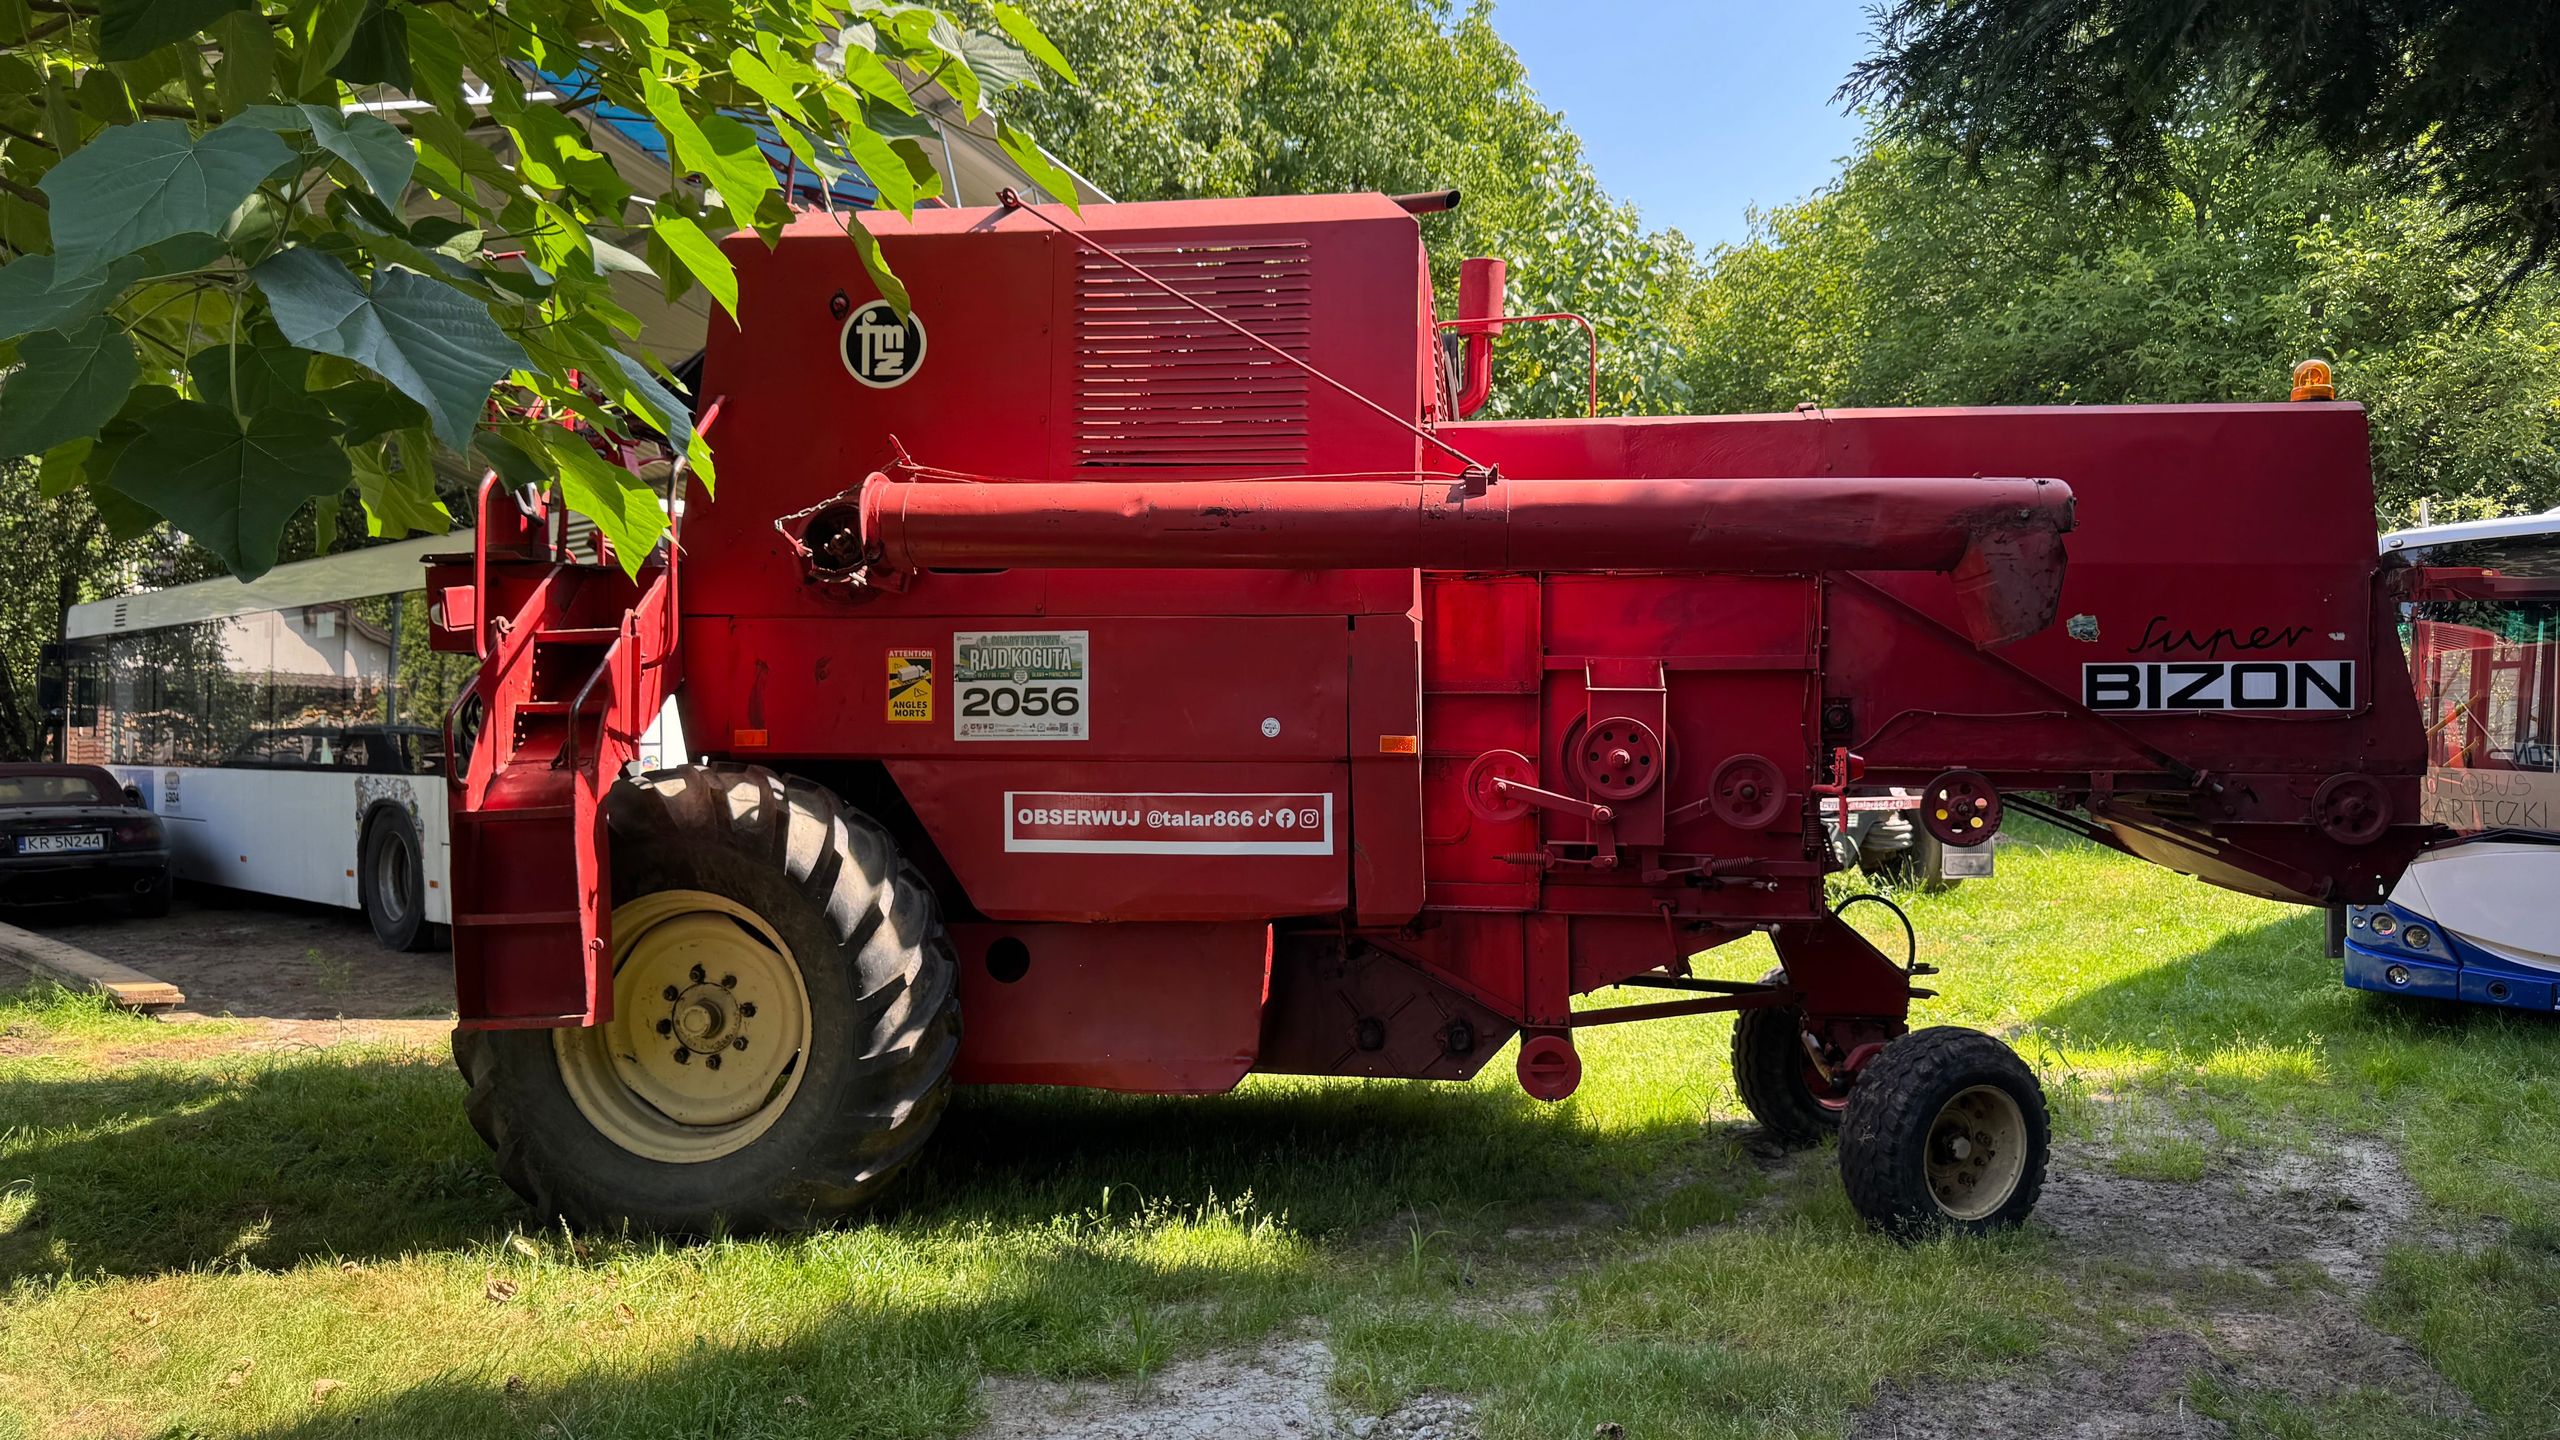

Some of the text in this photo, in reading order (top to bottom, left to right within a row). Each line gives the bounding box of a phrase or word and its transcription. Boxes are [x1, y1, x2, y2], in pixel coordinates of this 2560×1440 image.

[2127, 615, 2313, 659] Super
[969, 647, 1072, 671] RAJD KOGUTA
[2085, 662, 2352, 709] BIZON
[893, 701, 928, 709] ANGLES
[894, 709, 926, 717] MORTS
[962, 687, 1080, 717] 2056
[2425, 772, 2532, 797] UTOBUS
[1018, 808, 1254, 829] OBSERWUJ @talar866
[28, 834, 100, 850] KR 5N244
